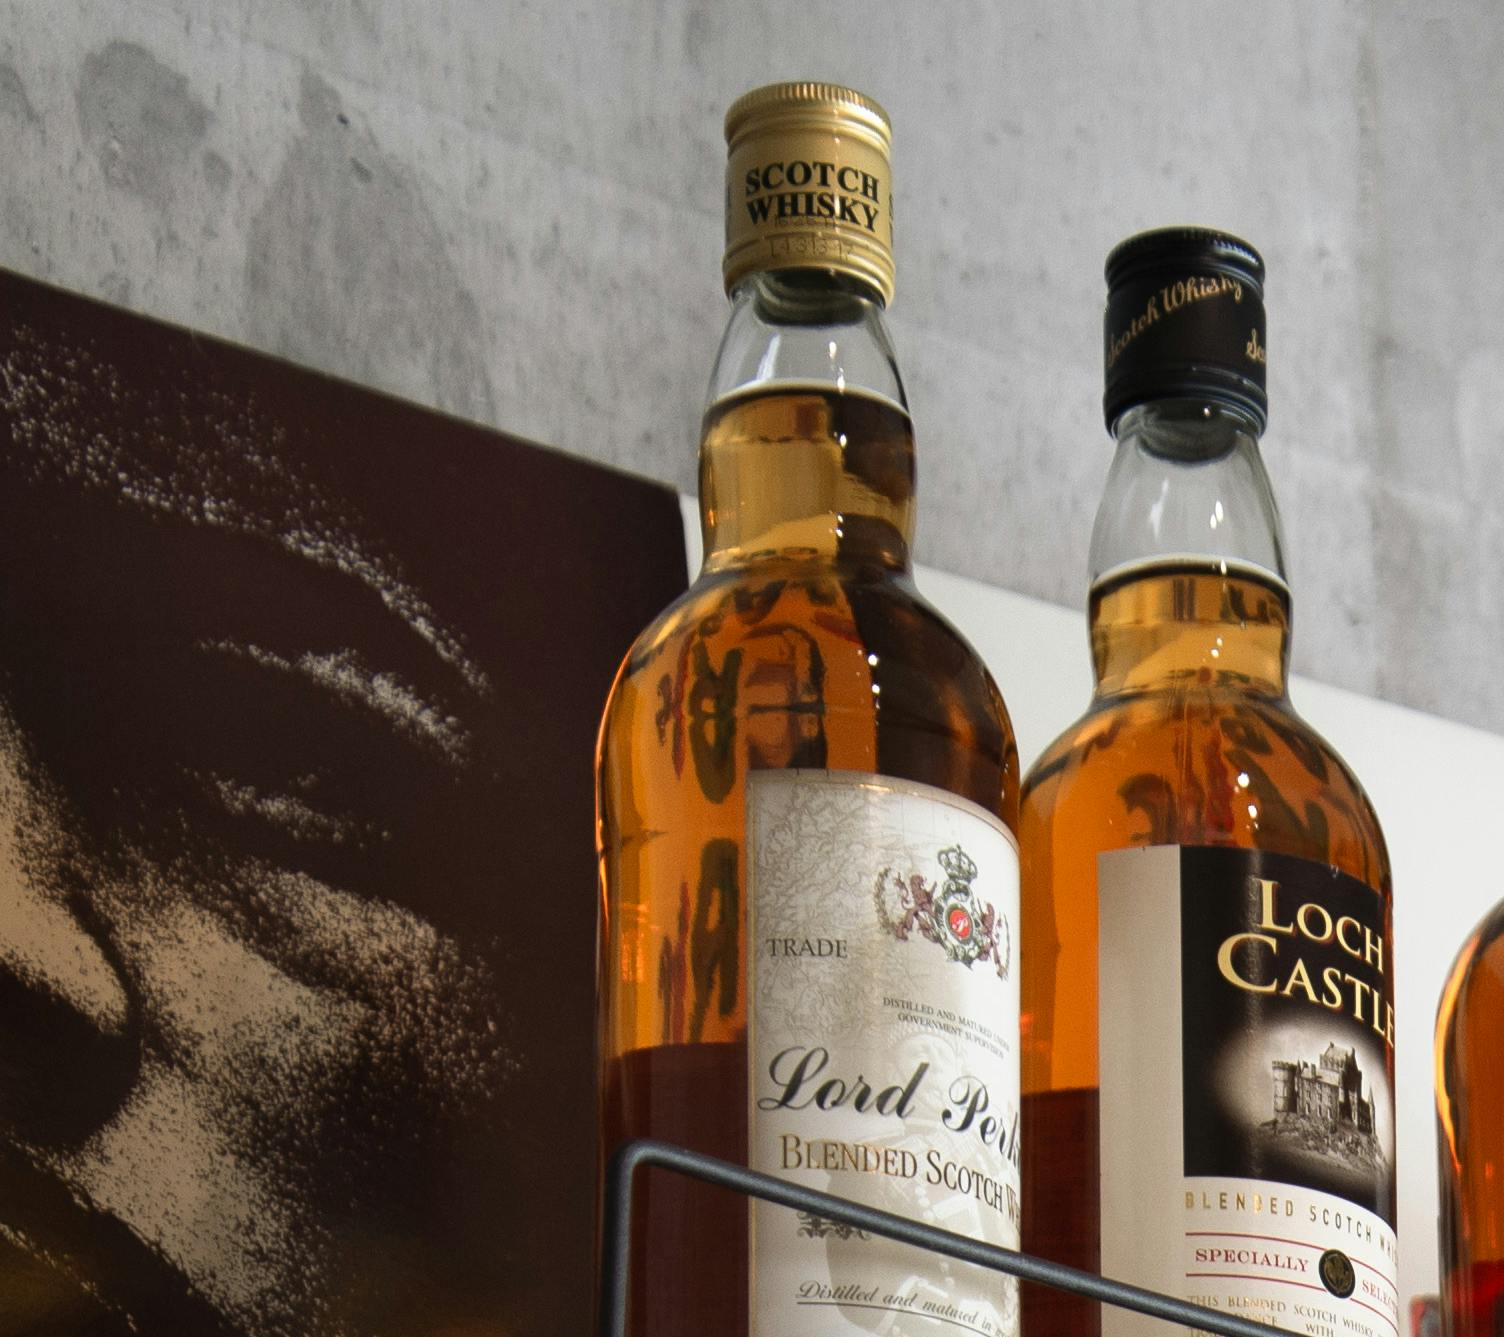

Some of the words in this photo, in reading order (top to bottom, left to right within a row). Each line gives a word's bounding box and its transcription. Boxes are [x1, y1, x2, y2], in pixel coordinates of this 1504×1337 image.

[746, 160, 879, 203] SCOTCH
[746, 192, 879, 232] WHISKY
[1161, 273, 1243, 304] Whisky
[1259, 878, 1384, 976] LOCH
[765, 937, 848, 960] TRADE
[883, 996, 934, 1016] DISTILLED
[937, 1007, 957, 1022] AND
[1217, 932, 1395, 1049] CASTLE
[897, 1011, 963, 1037] GOVERNMENT
[757, 1046, 930, 1119] Lord
[779, 1133, 918, 1179] BLENDED
[926, 1150, 1004, 1214] SCOTCH
[1183, 1190, 1295, 1217] BLENDED
[1309, 1204, 1373, 1242] SCOTCH
[1195, 1248, 1310, 1273] SPECIALLY
[799, 1281, 877, 1303] Distilled
[882, 1293, 918, 1308] and
[922, 1300, 979, 1325] matured
[1227, 1297, 1287, 1312] BLENDED
[1293, 1305, 1338, 1325] SCOTCH
